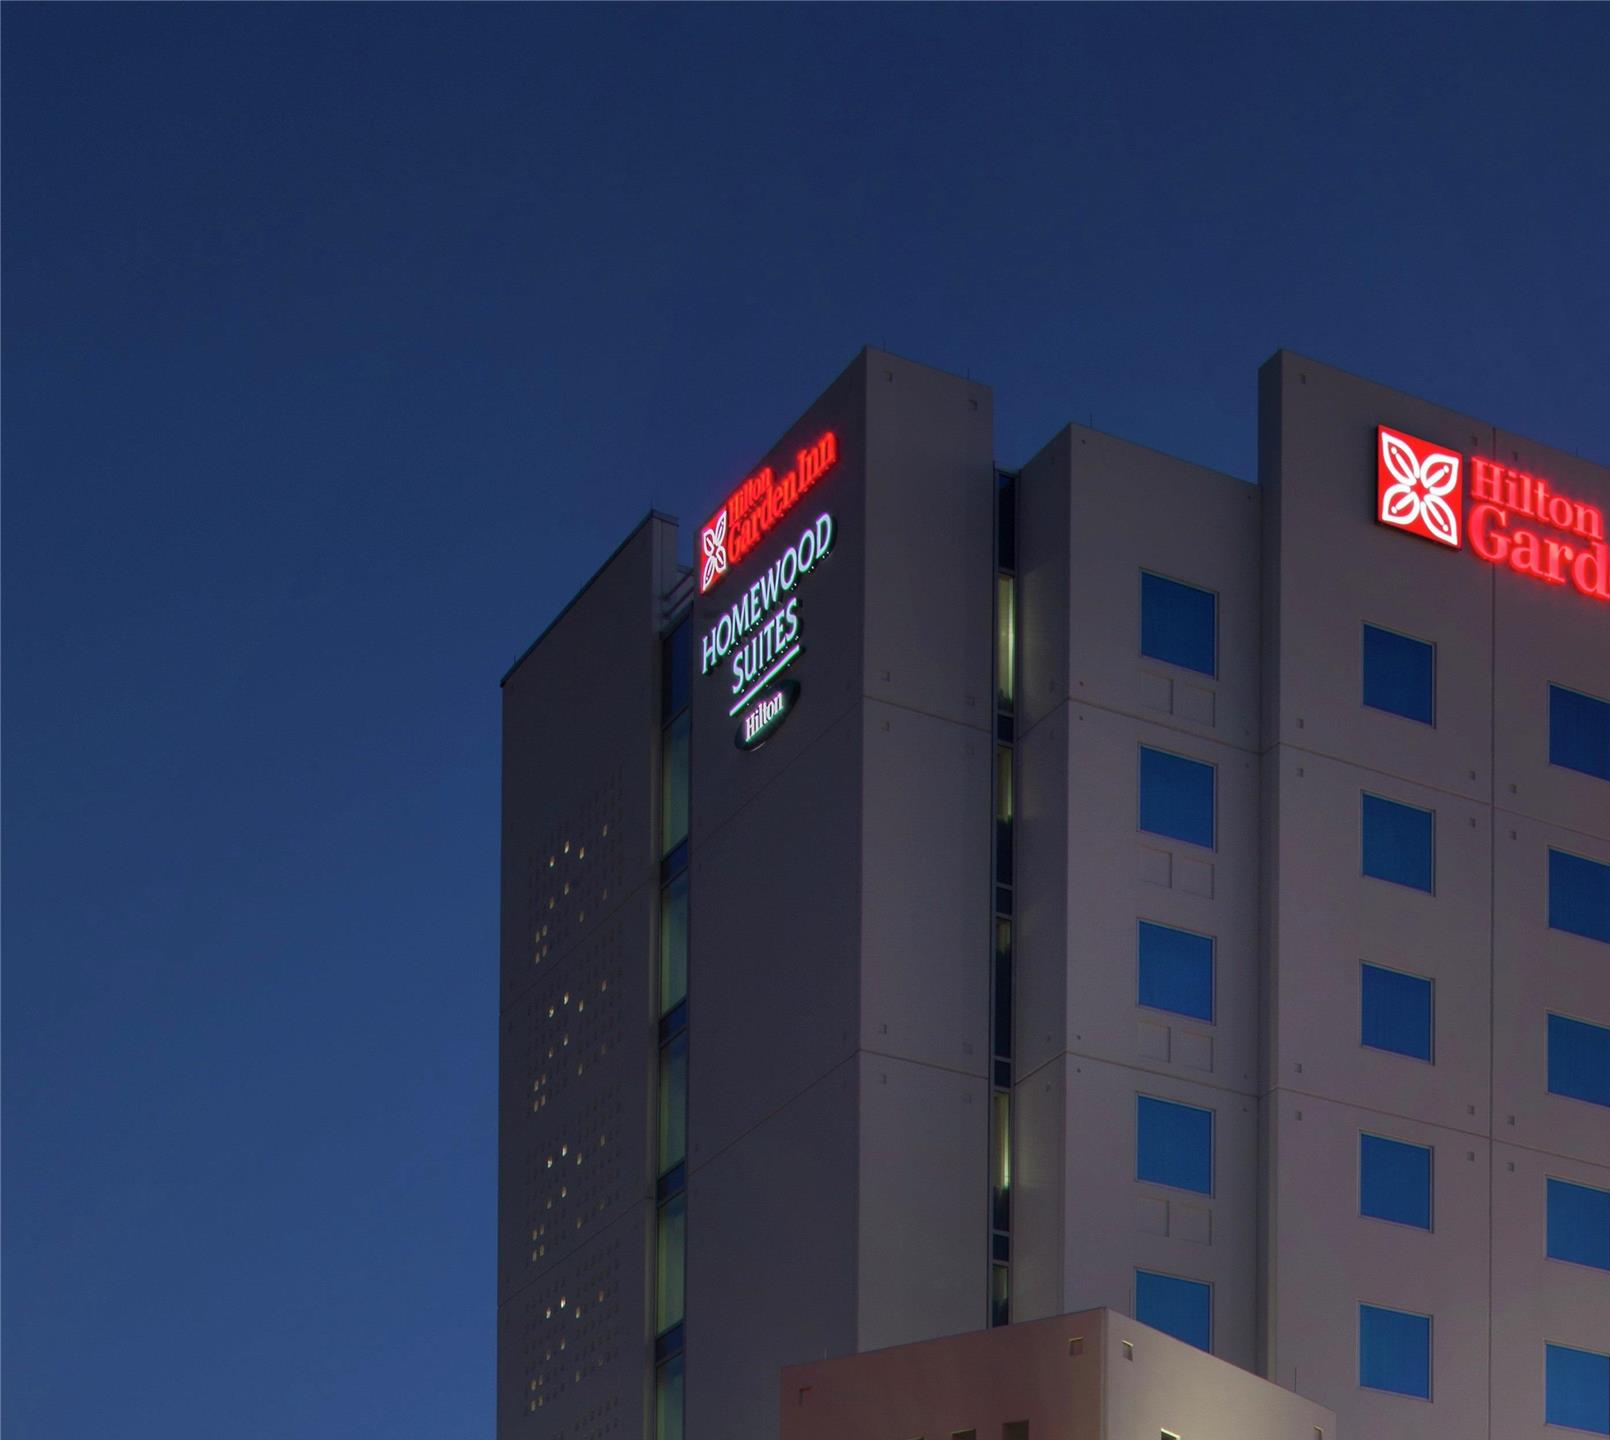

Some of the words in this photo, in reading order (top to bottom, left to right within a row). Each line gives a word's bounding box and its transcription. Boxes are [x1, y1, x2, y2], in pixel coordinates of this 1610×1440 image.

[727, 467, 772, 527] Hilton
[727, 474, 798, 564] Garden
[796, 431, 837, 493] Inn
[1471, 456, 1604, 540] Hilton
[702, 513, 834, 675] HOMEWOOD
[732, 598, 799, 695] SUITES
[745, 693, 784, 742] Hilton
